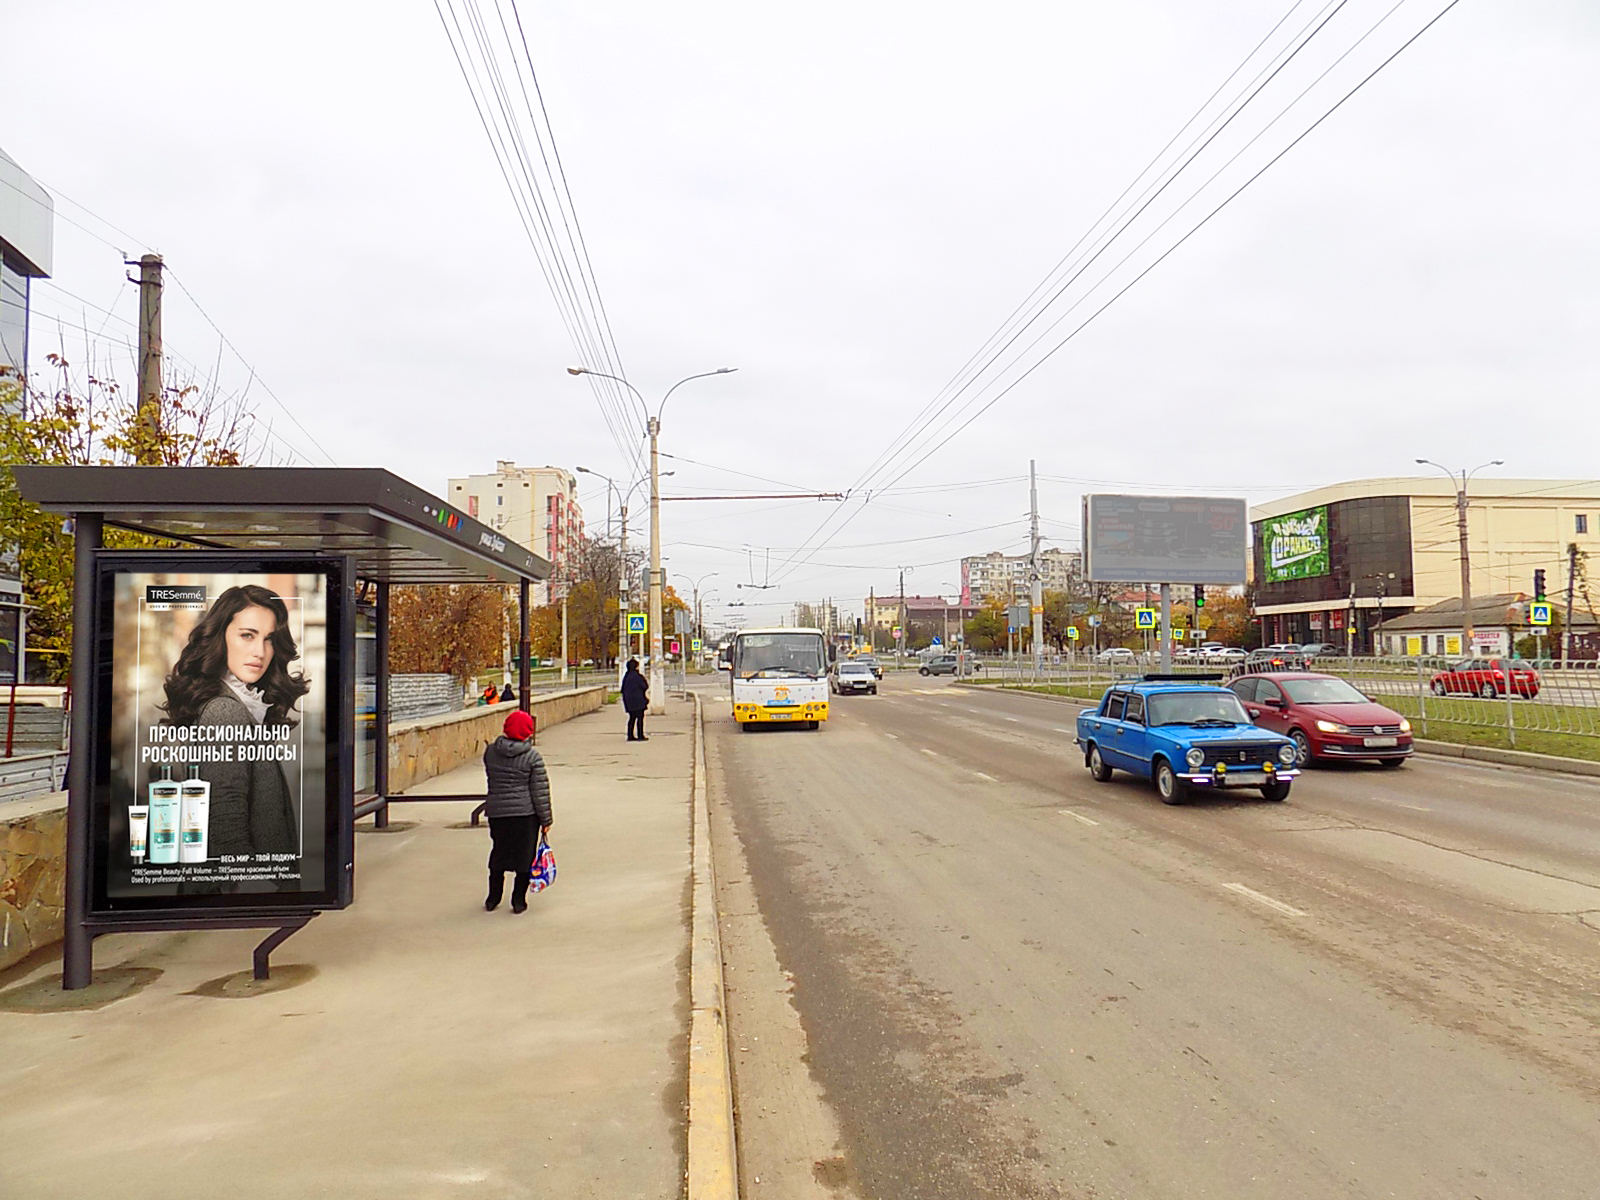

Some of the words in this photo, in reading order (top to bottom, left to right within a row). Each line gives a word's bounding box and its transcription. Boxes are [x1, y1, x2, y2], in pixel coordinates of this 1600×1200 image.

[1210, 506, 1237, 514] СКИДКА
[149, 724, 290, 743] ПРОФЕССИОНАЛЬНО
[142, 745, 234, 763] РОСКОШНЫЕ
[237, 744, 297, 761] ВОЛОСЫ
[220, 854, 235, 863] ВЕСЬ
[236, 854, 250, 862] МИР
[255, 853, 270, 862] ТВОЙ
[271, 854, 296, 862] ПОДИУМ
[193, 867, 212, 875] Volume
[131, 876, 144, 884] Used
[145, 876, 151, 885] by
[151, 875, 186, 884] professionals
